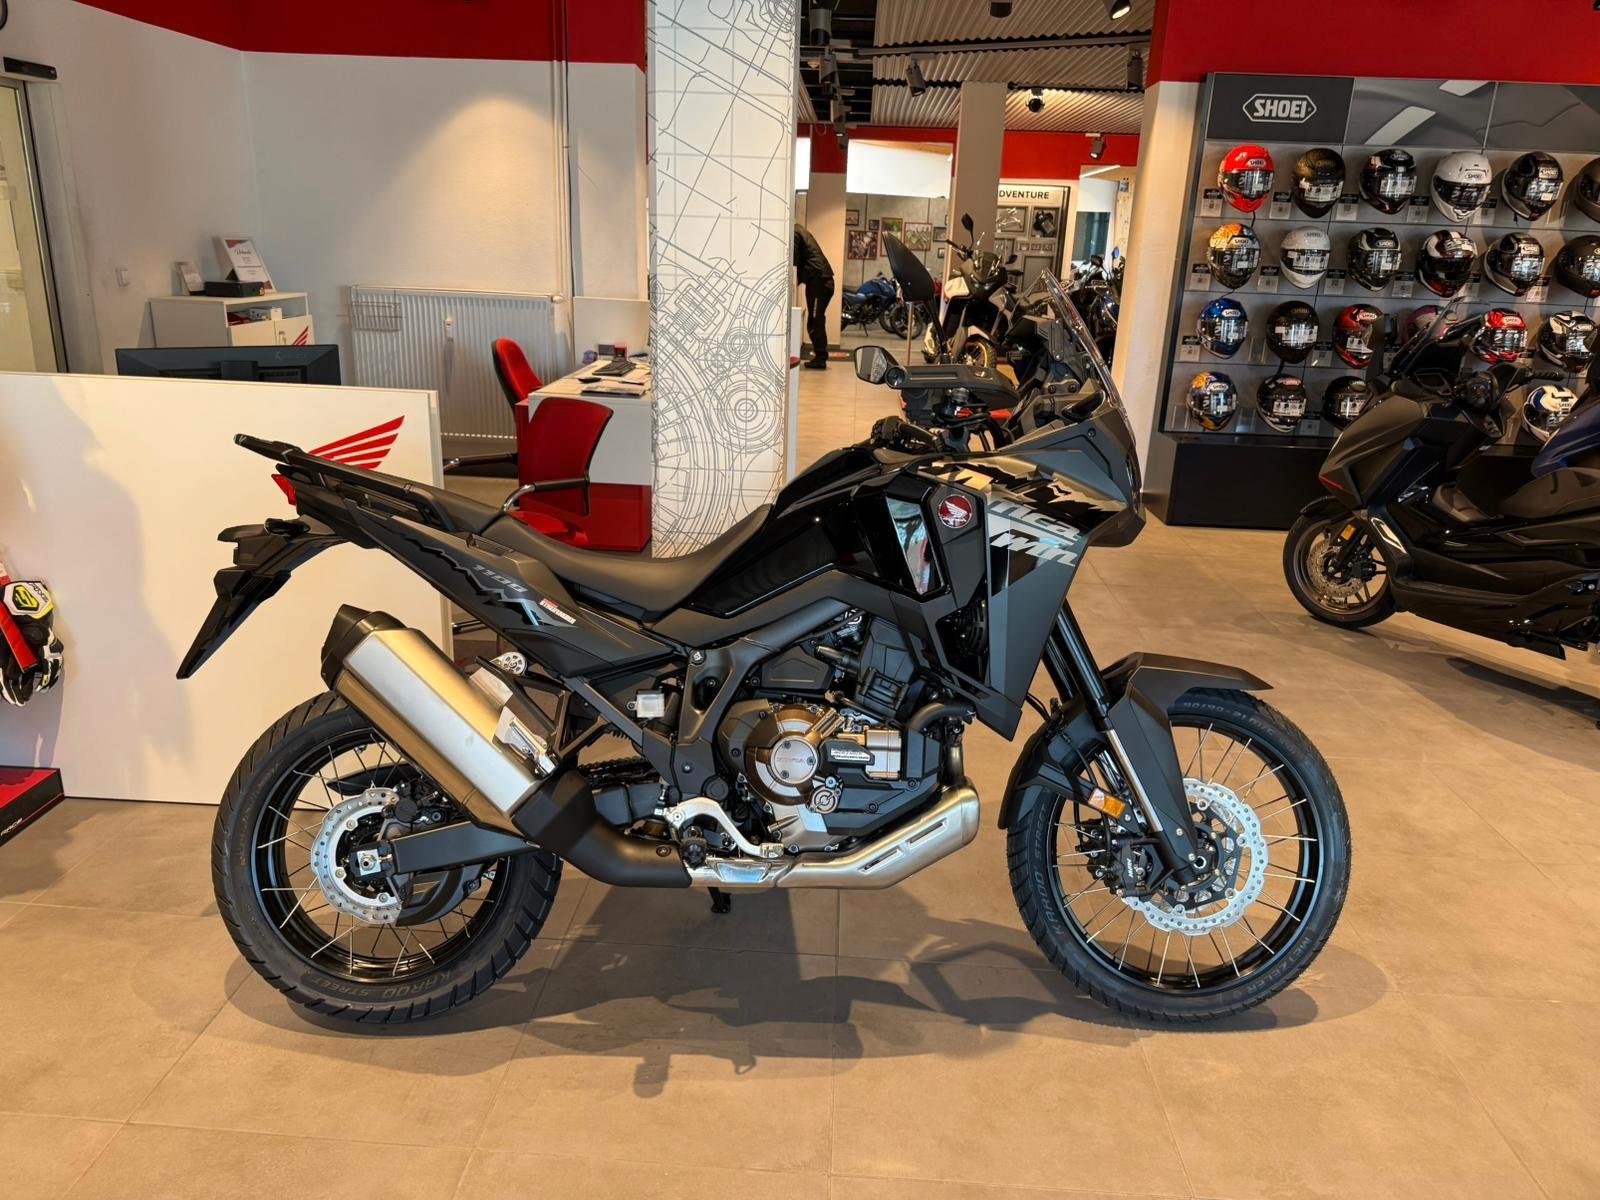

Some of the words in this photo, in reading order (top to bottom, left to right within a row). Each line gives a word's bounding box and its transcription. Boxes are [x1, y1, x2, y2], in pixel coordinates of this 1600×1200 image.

[1253, 98, 1307, 118] SHOEI
[1247, 936, 1311, 994] METZELER
[311, 976, 370, 997] STREET
[383, 969, 451, 998] KAROO
